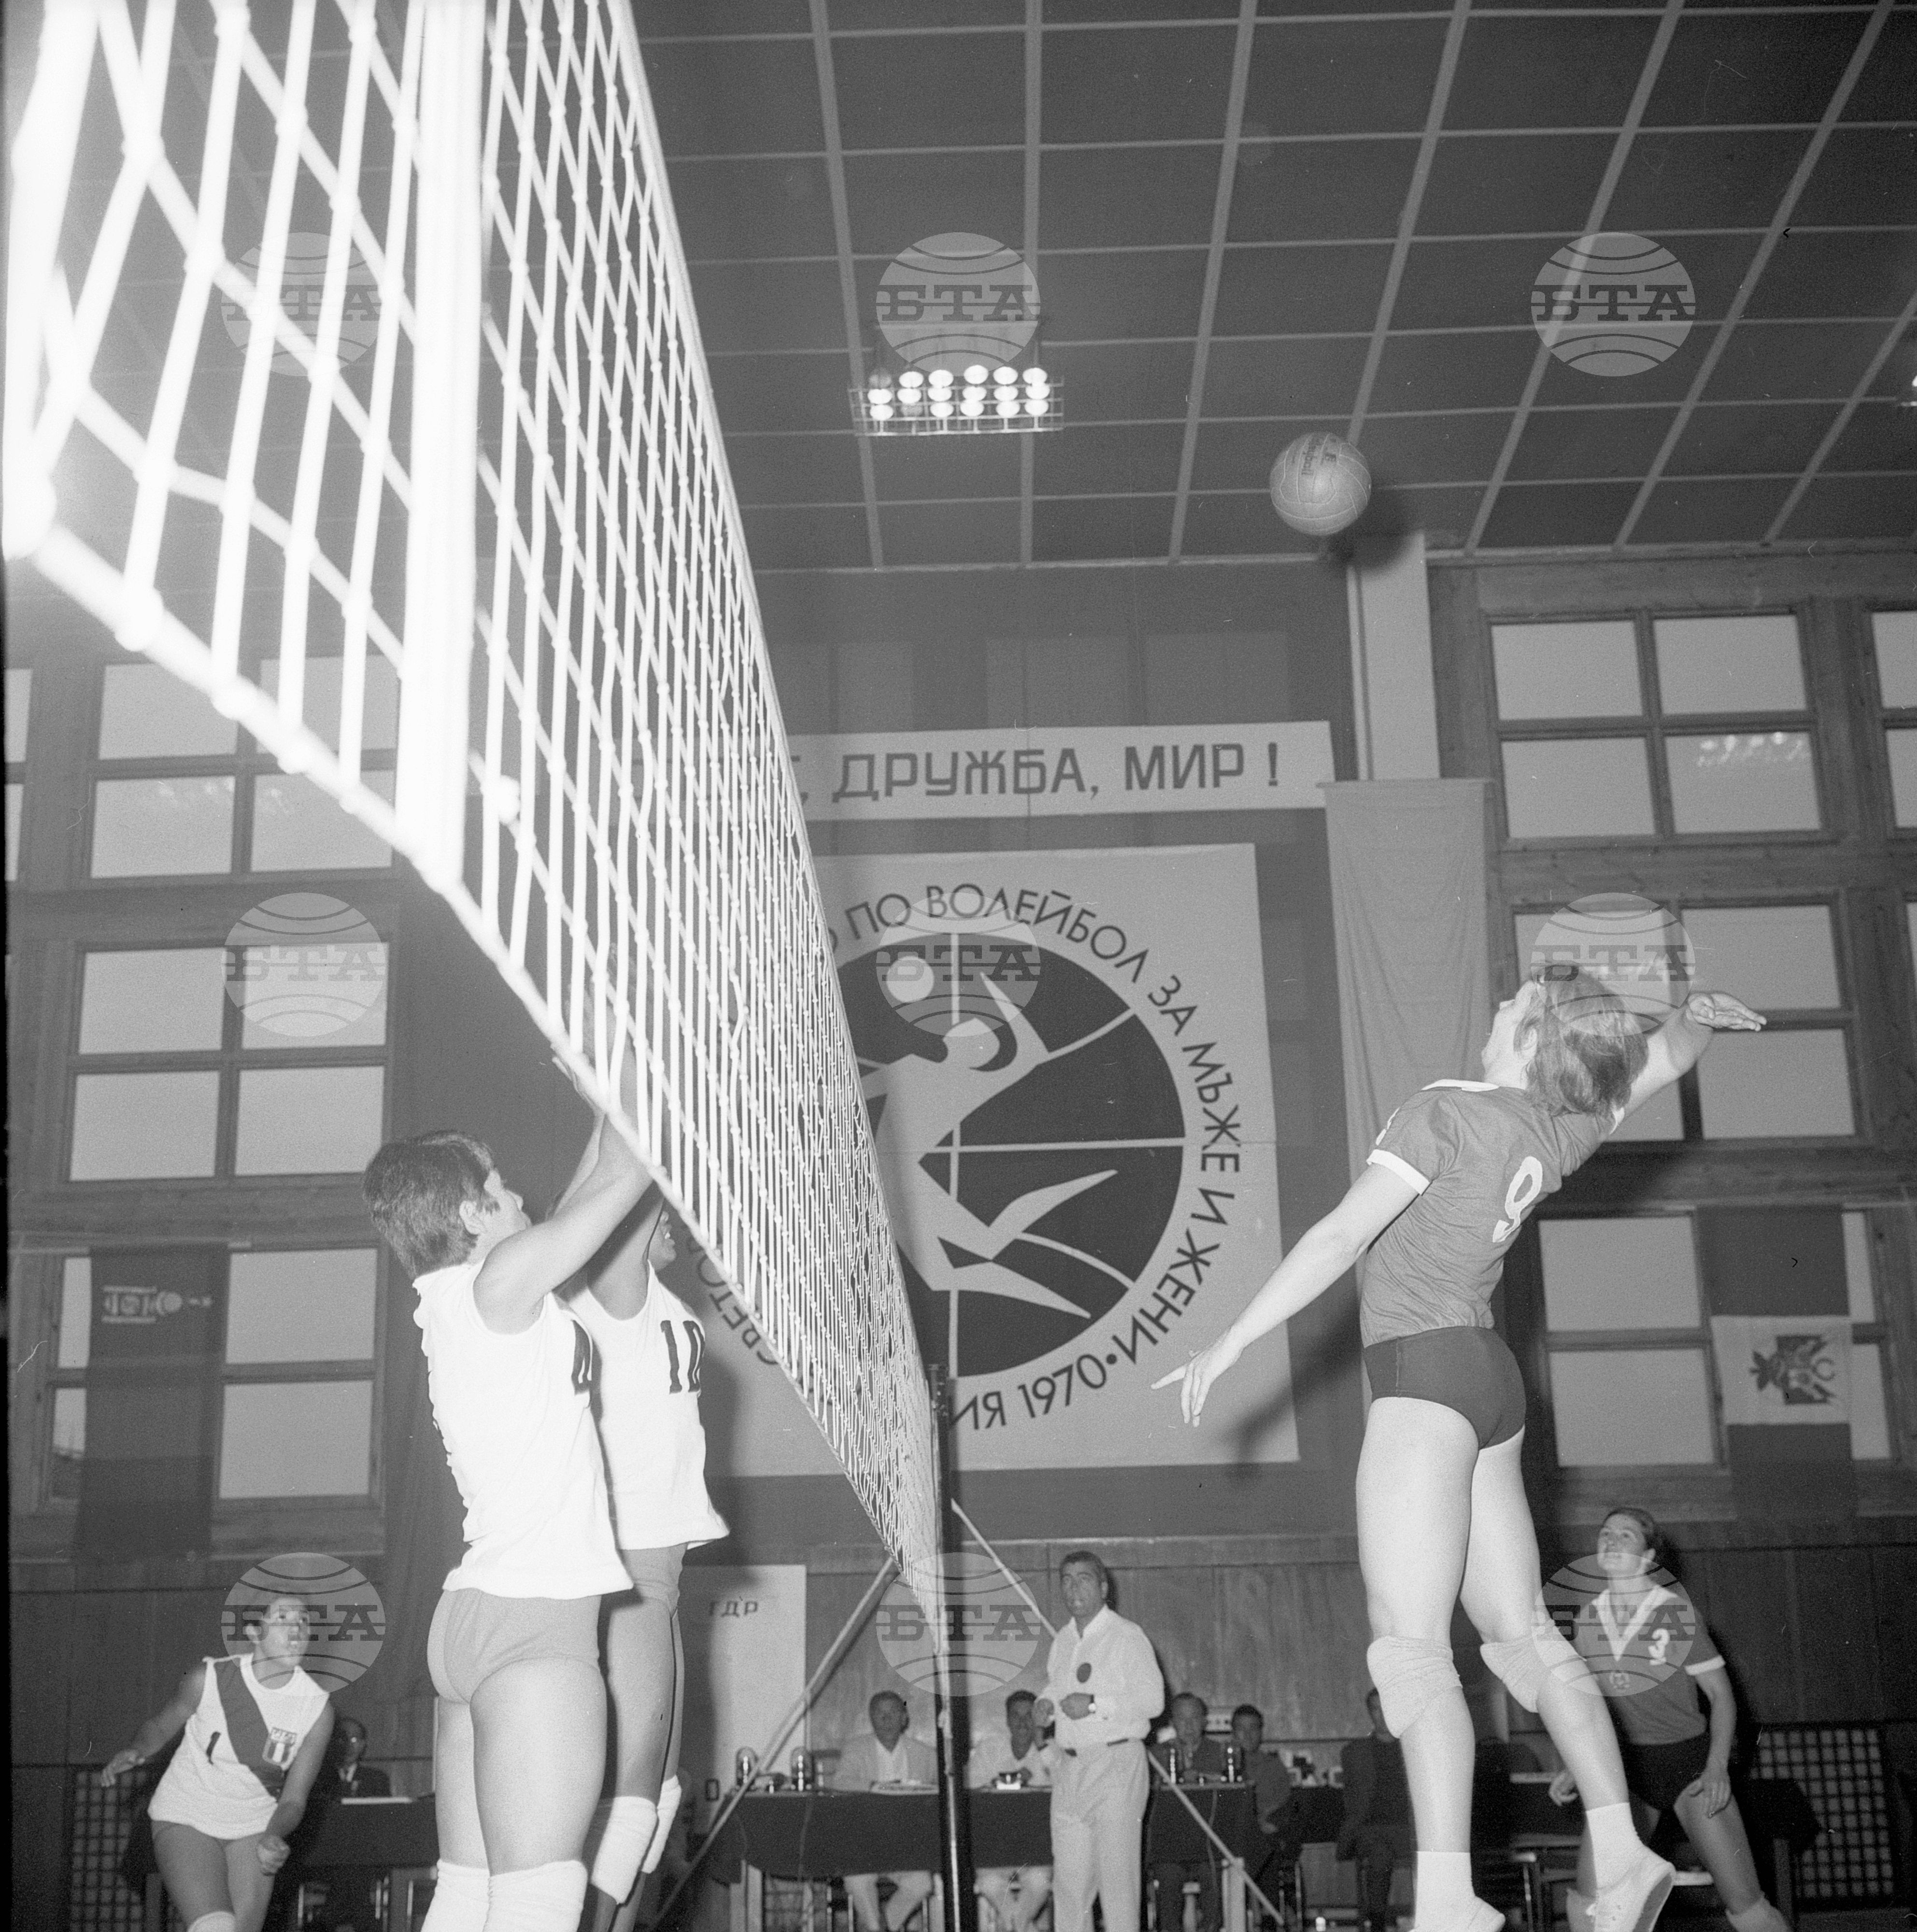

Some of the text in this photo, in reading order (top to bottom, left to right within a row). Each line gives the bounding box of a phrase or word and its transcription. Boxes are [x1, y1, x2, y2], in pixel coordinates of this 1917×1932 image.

[831, 747, 1100, 803] ДРУЖБА,
[1125, 742, 1245, 791] МИР
[845, 883, 1241, 1364] ПО ВОЛЕЙБОЛ ЗА МЪЖЕ И ЖЕНИ
[1492, 1156, 1543, 1243] 9
[709, 1600, 758, 1618] ГДР
[1648, 1628, 1671, 1665] 3
